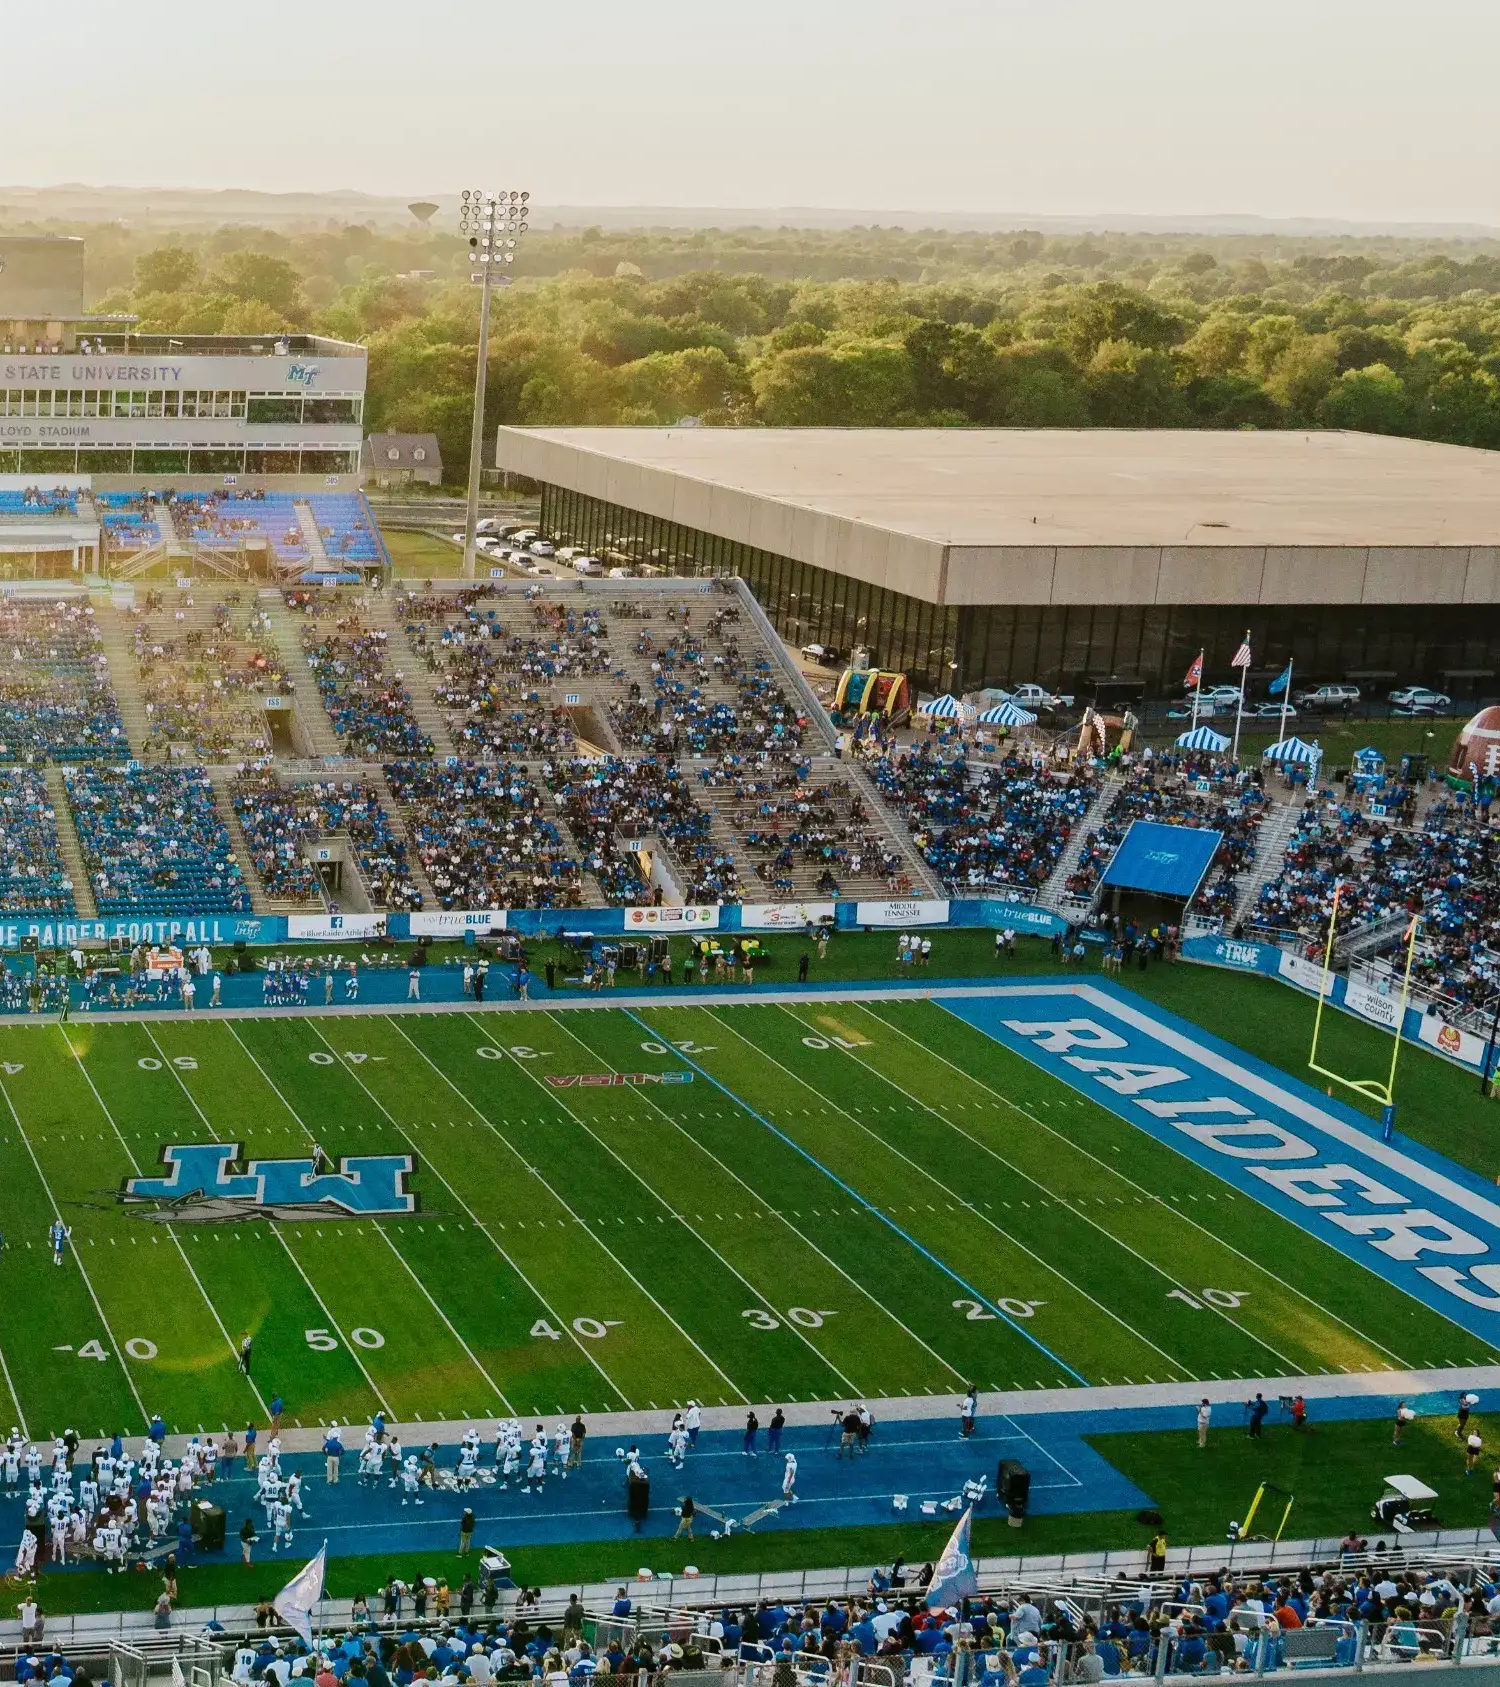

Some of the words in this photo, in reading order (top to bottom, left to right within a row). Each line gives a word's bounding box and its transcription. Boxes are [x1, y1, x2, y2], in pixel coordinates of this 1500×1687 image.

[5, 365, 61, 381] STATE
[72, 366, 183, 382] UNIVERSITY
[286, 363, 318, 386] MT
[39, 426, 91, 438] STADIUM
[1197, 782, 1207, 790] 2A
[1373, 805, 1384, 814] 3A
[884, 909, 920, 917] TENNESSEE
[116, 920, 224, 944] FOOTBALL
[1367, 994, 1394, 1013] wilson
[1364, 1003, 1395, 1023] county
[641, 1040, 701, 1054] 20
[802, 1035, 860, 1048] 10
[308, 1051, 371, 1065] 40
[476, 1046, 539, 1060] 30
[137, 1056, 199, 1070] 50
[1166, 1288, 1242, 1309] 10
[741, 1306, 824, 1329] 30
[951, 1297, 1036, 1321] 20
[529, 1316, 608, 1340] 40
[305, 1326, 386, 1351] 50
[75, 1338, 158, 1362] 40
